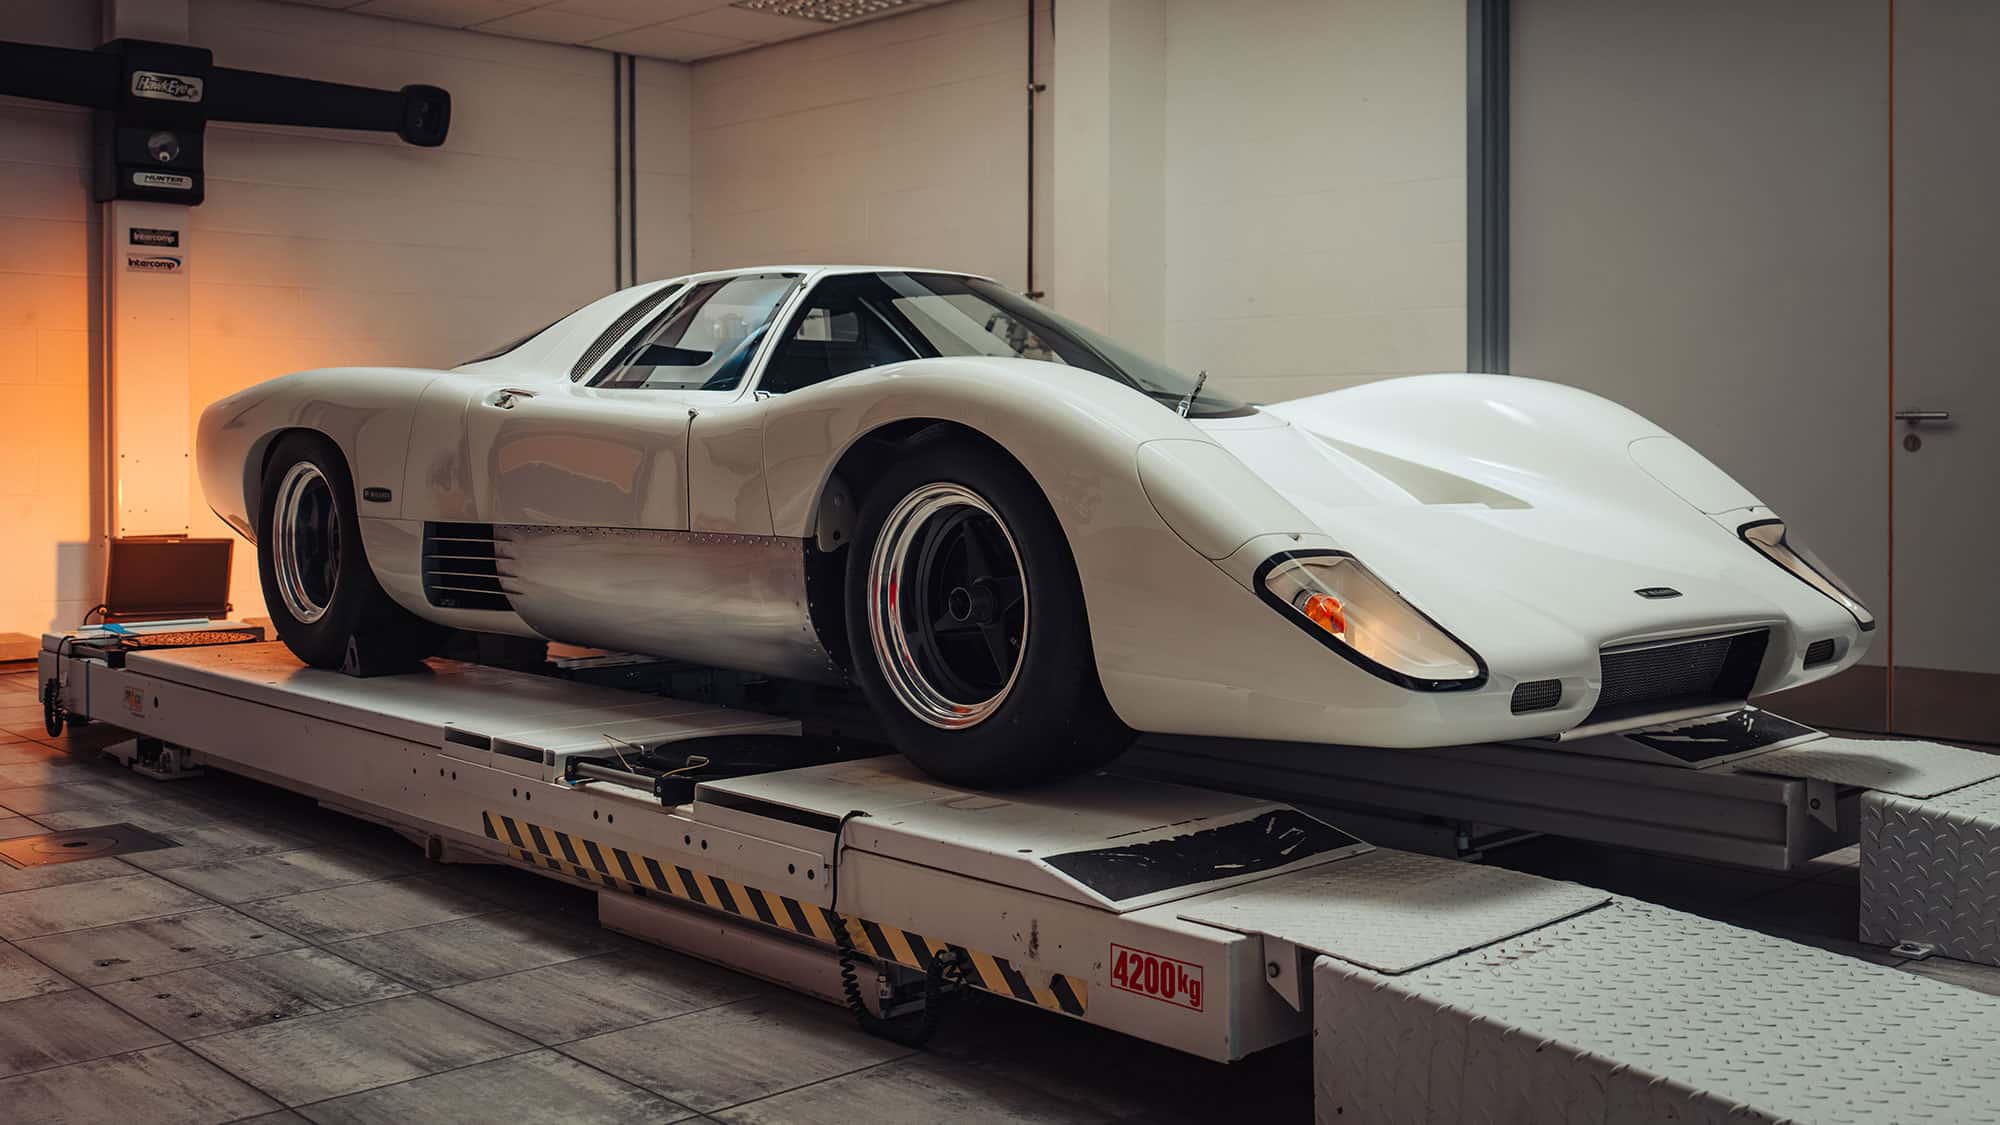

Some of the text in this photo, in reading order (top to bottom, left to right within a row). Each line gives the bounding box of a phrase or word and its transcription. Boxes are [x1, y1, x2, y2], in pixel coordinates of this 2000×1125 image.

[137, 76, 188, 96] HawkEye
[145, 174, 184, 183] HUNTER
[128, 257, 176, 270] Intercomp
